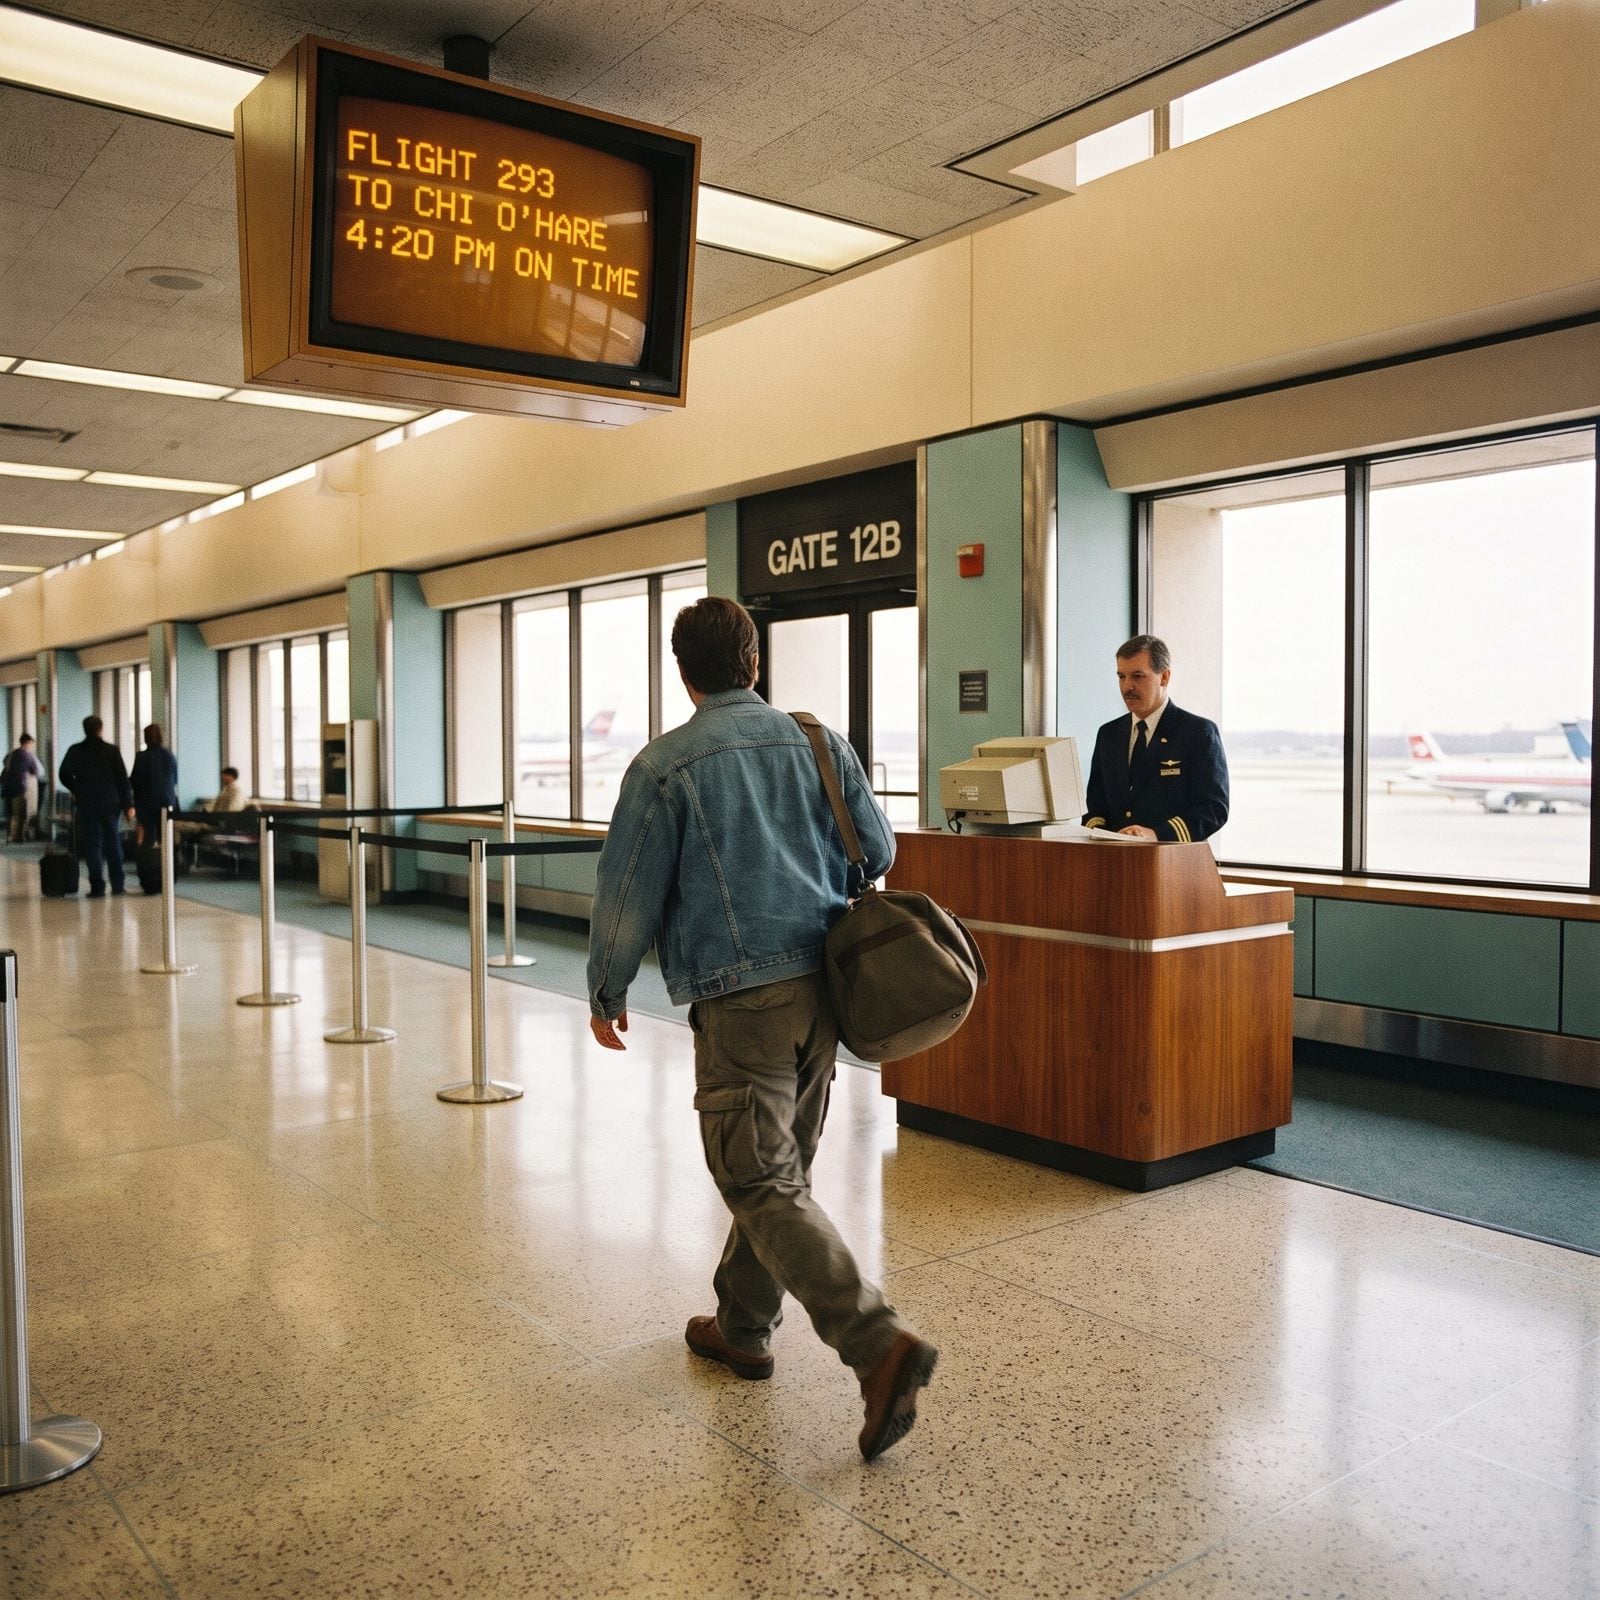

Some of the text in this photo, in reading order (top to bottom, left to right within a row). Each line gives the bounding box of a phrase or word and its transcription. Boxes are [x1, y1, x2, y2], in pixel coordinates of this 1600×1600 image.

[348, 130, 555, 199] FLIGHT 293
[348, 174, 608, 251] TO CHI O'HARE
[346, 219, 640, 298] 4:20 PM ON TIME
[767, 520, 901, 576] GATE 12B
